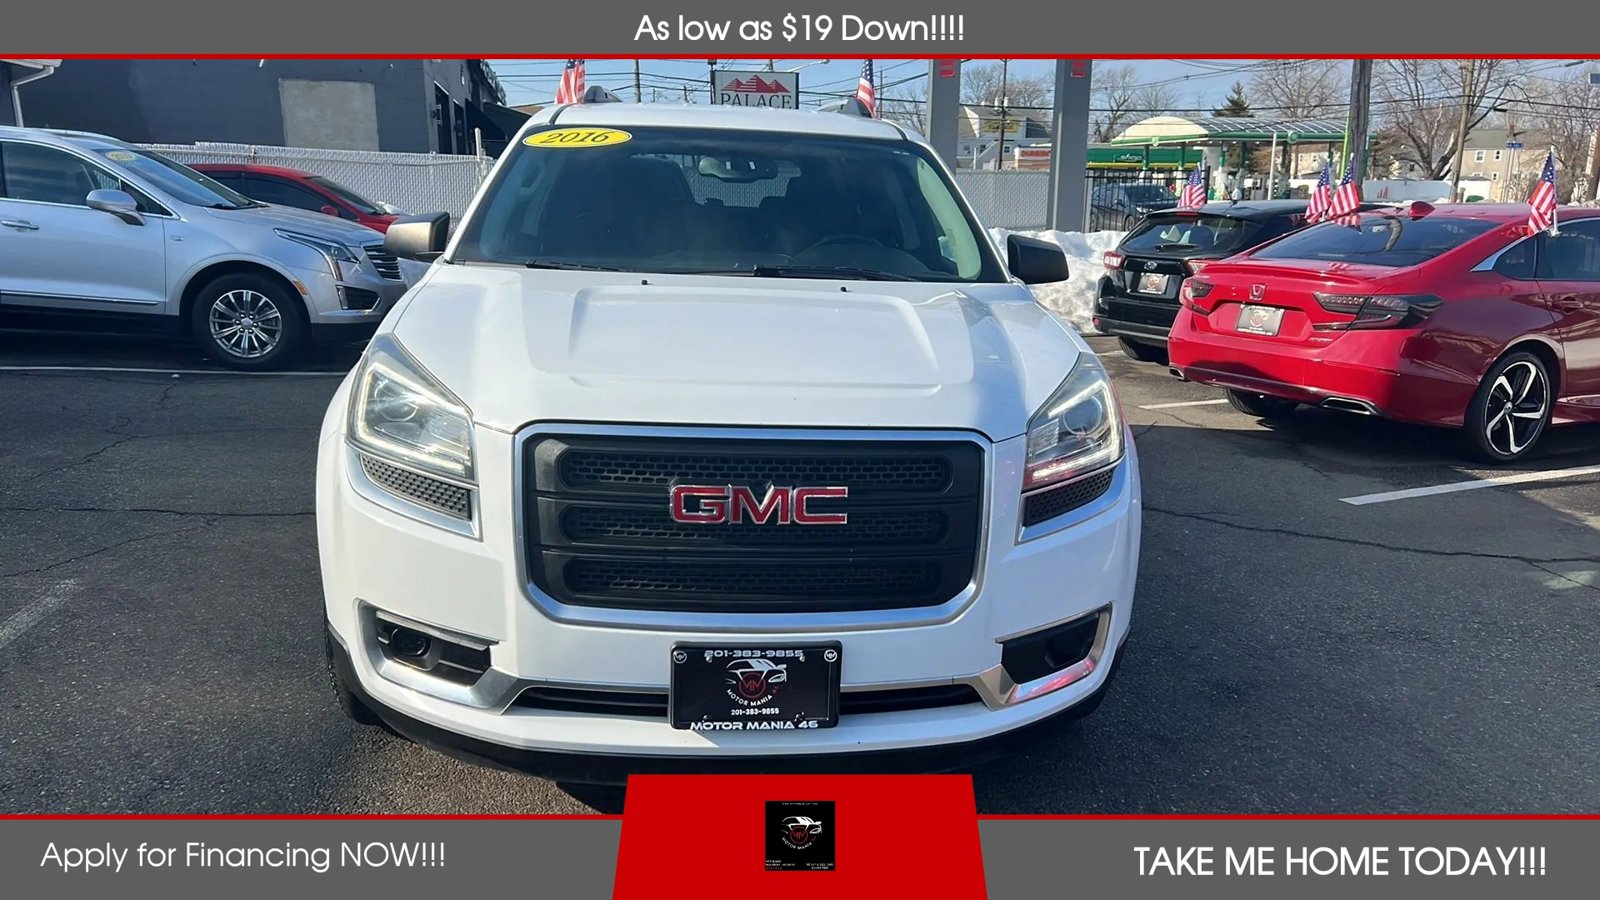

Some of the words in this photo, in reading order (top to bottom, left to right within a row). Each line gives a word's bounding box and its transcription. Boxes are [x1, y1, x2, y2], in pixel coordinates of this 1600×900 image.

[720, 93, 792, 109] PALACE
[540, 131, 615, 143] 2016
[669, 483, 848, 525] GMC
[704, 649, 804, 658] 201-383-9855
[726, 688, 749, 706] MOTOR
[750, 694, 773, 707] MANIA
[689, 721, 744, 731] MOTOR
[746, 720, 795, 730] MANIA
[798, 720, 819, 729] 46
